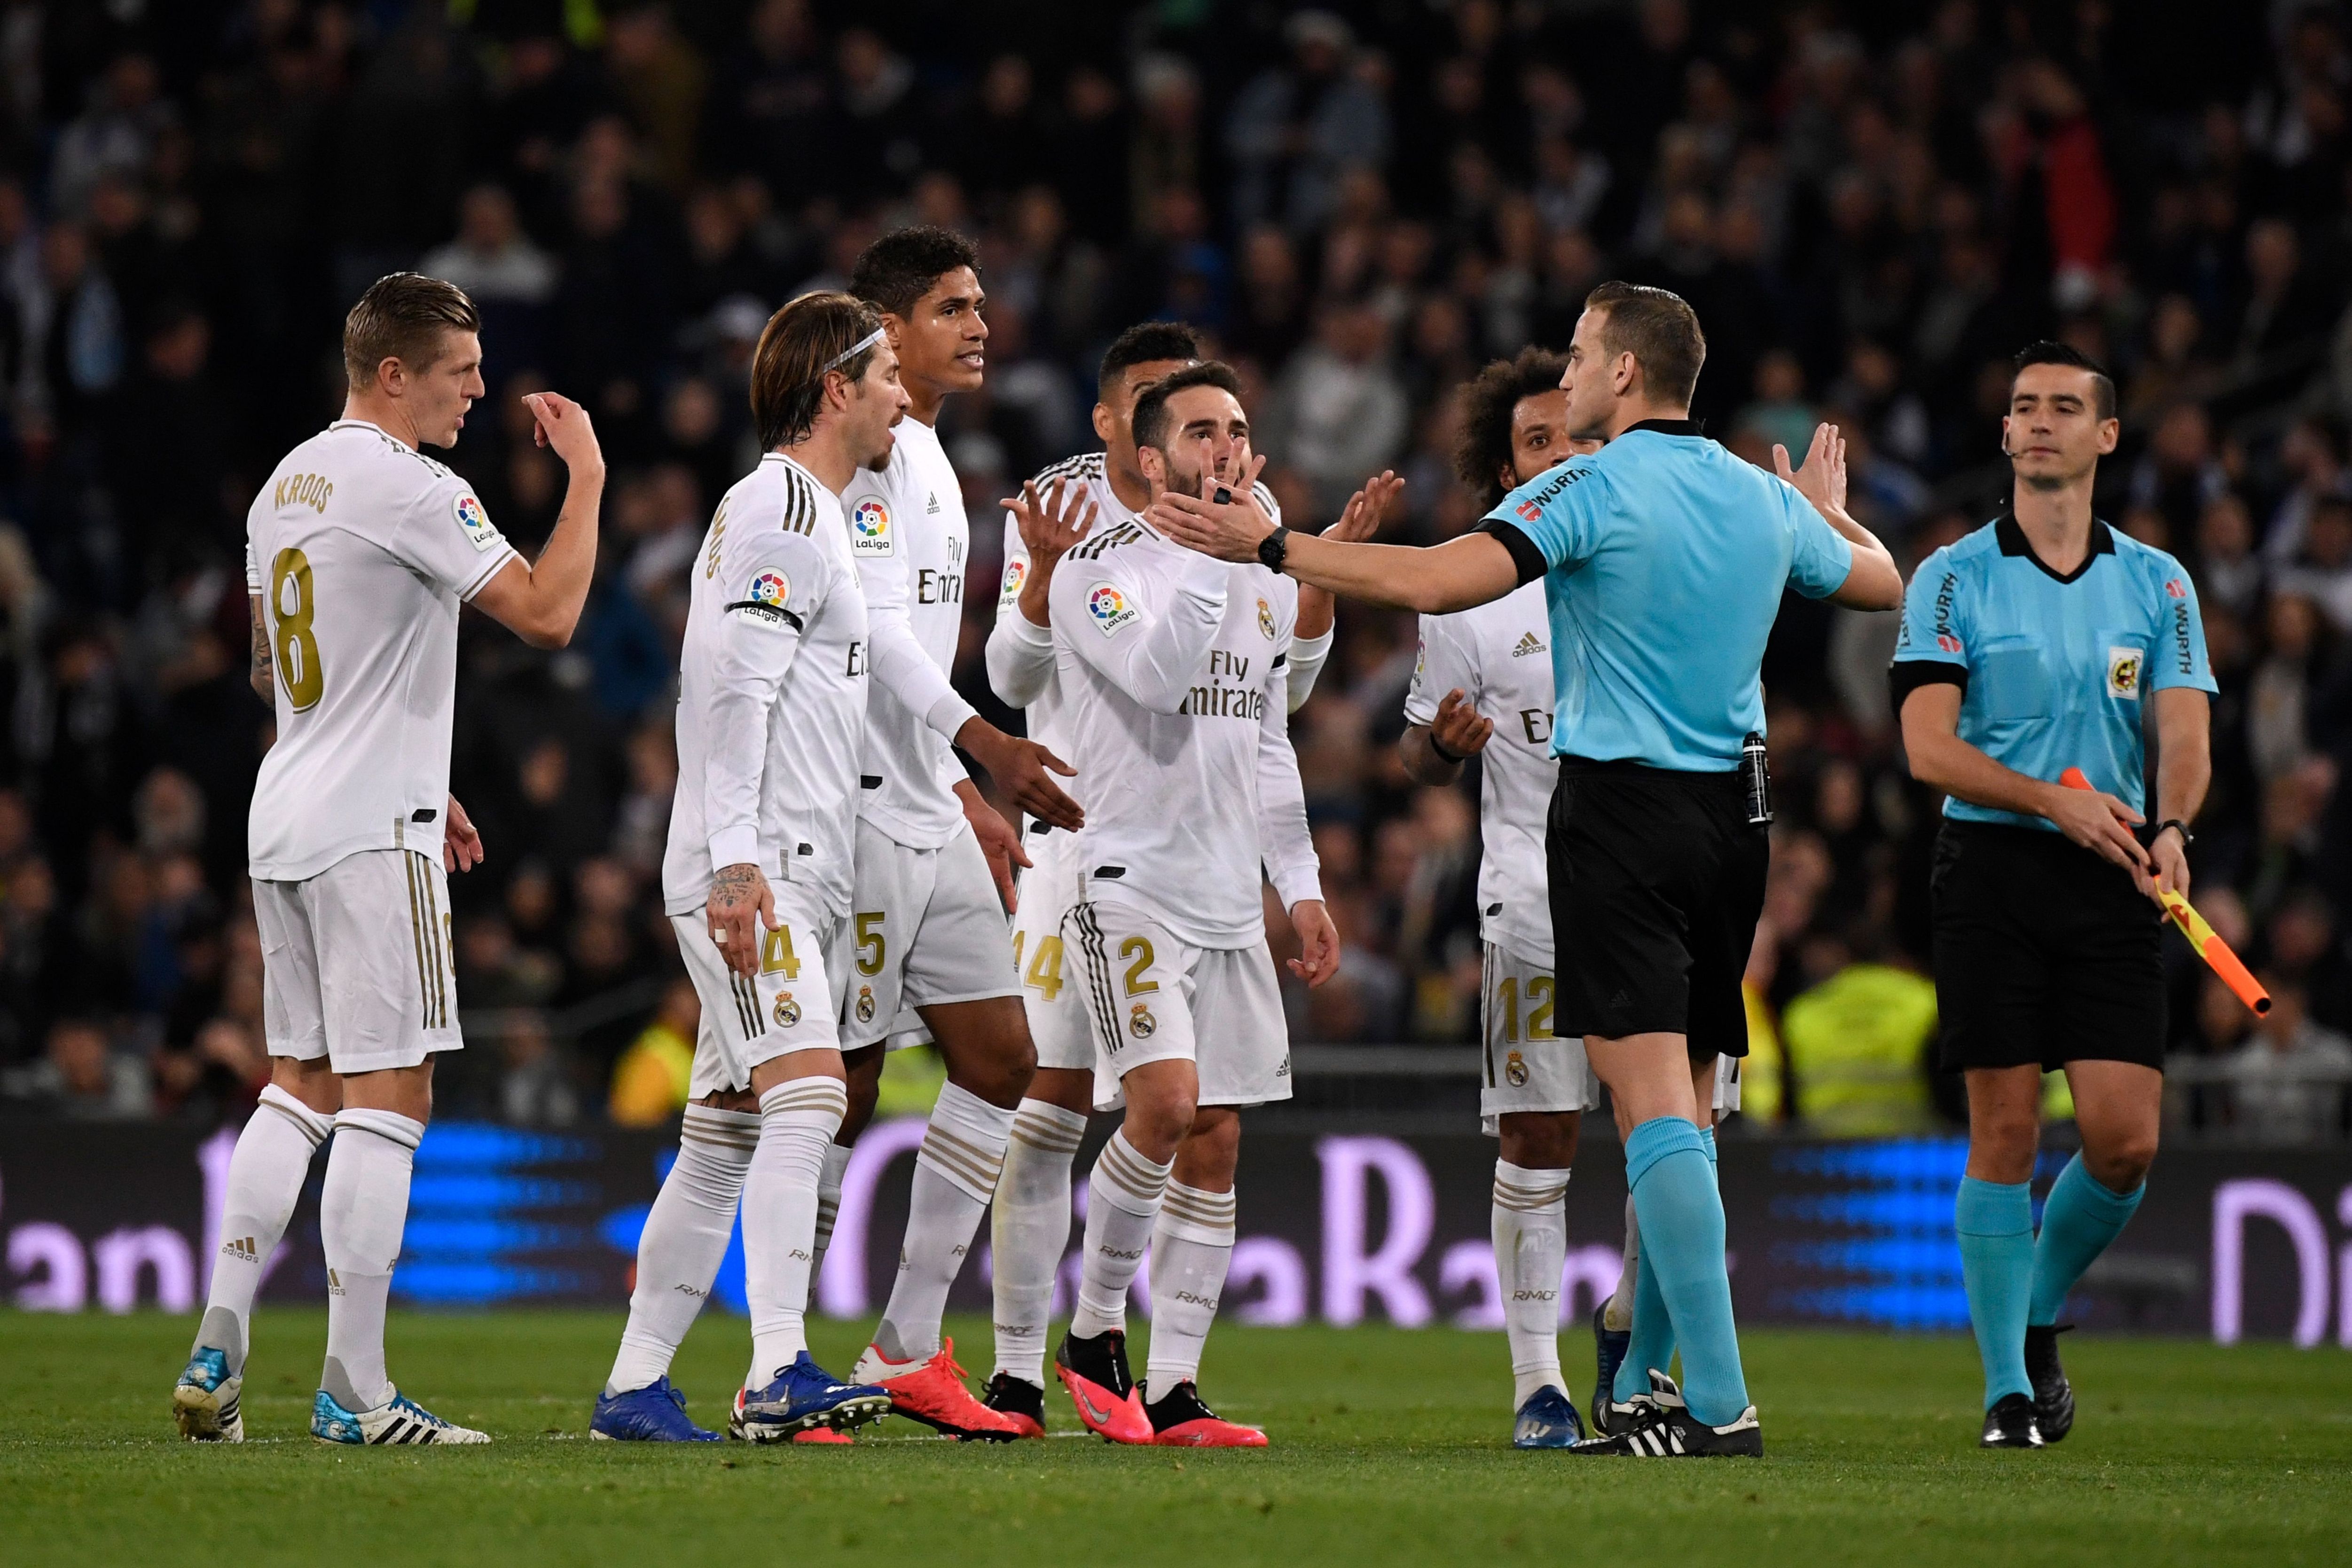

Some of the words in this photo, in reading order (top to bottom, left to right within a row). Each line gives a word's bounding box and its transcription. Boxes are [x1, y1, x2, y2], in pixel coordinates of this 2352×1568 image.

[274, 473, 333, 514] KROOS
[1531, 469, 1593, 507] WÜRTH
[856, 539, 890, 550] LaLiga
[948, 536, 962, 567] Fly
[272, 547, 323, 714] 8
[745, 606, 778, 623] LaLiga
[1103, 610, 1135, 631] LaLiga
[1210, 650, 1249, 682] Fly
[1512, 645, 1547, 658] adidas
[1179, 678, 1262, 720] mirate
[760, 924, 801, 981] 4
[855, 911, 885, 977] 5
[1118, 936, 1160, 999] 2
[1497, 976, 1560, 1043] 12
[222, 1247, 259, 1263] adidas
[1513, 1290, 1557, 1301] RMCF
